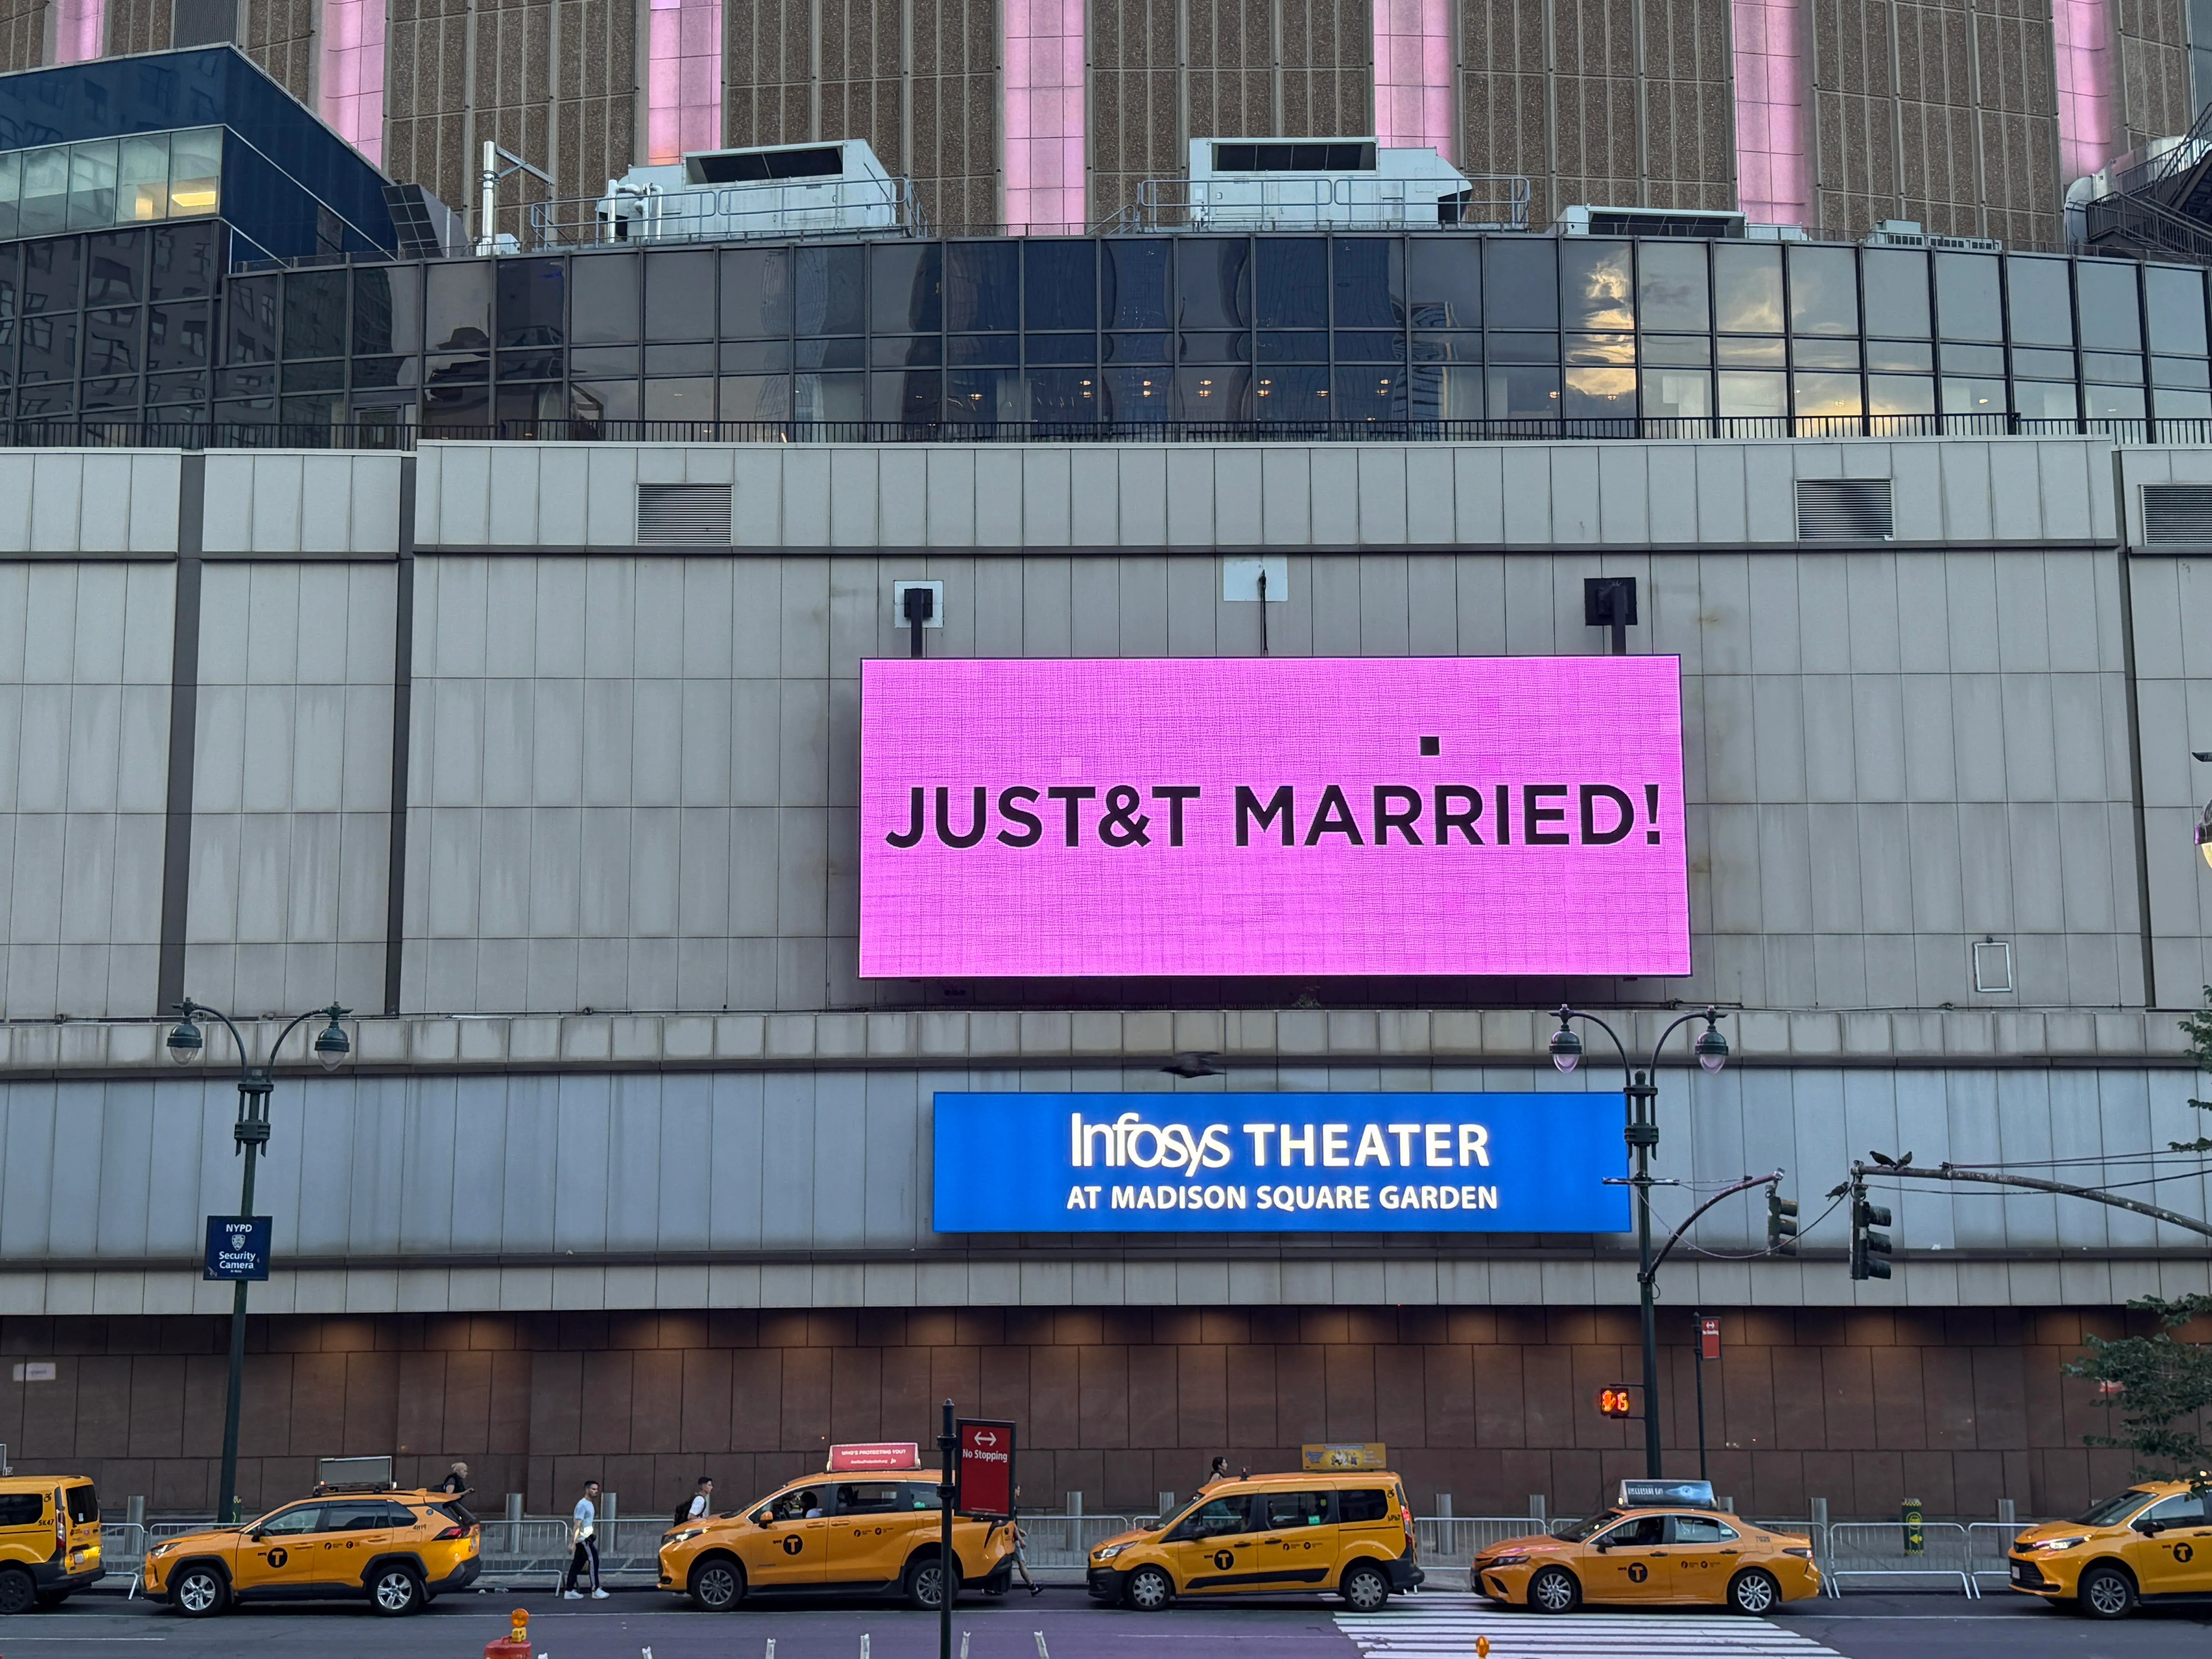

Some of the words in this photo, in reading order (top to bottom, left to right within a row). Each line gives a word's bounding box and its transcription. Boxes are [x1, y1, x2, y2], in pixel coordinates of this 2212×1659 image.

[885, 785, 1200, 848] JUST&T
[1235, 784, 1660, 846] MARRIED!
[1071, 1112, 1231, 1178] Infosys
[1243, 1123, 1490, 1167] THEATER
[1066, 1185, 1102, 1209] AT
[1111, 1185, 1247, 1209] MADISON
[1257, 1185, 1370, 1212] SQUARE
[1379, 1185, 1497, 1209] GARDEN
[226, 1224, 252, 1232] NYPD
[219, 1251, 256, 1262] Security
[219, 1261, 254, 1269] Camera
[963, 1449, 973, 1458] No
[974, 1449, 1008, 1463] Stopping
[787, 1538, 799, 1553] T
[272, 1551, 283, 1566] T
[1218, 1553, 1230, 1568] T
[2177, 1546, 2189, 1561] T
[1632, 1566, 1644, 1581] T
